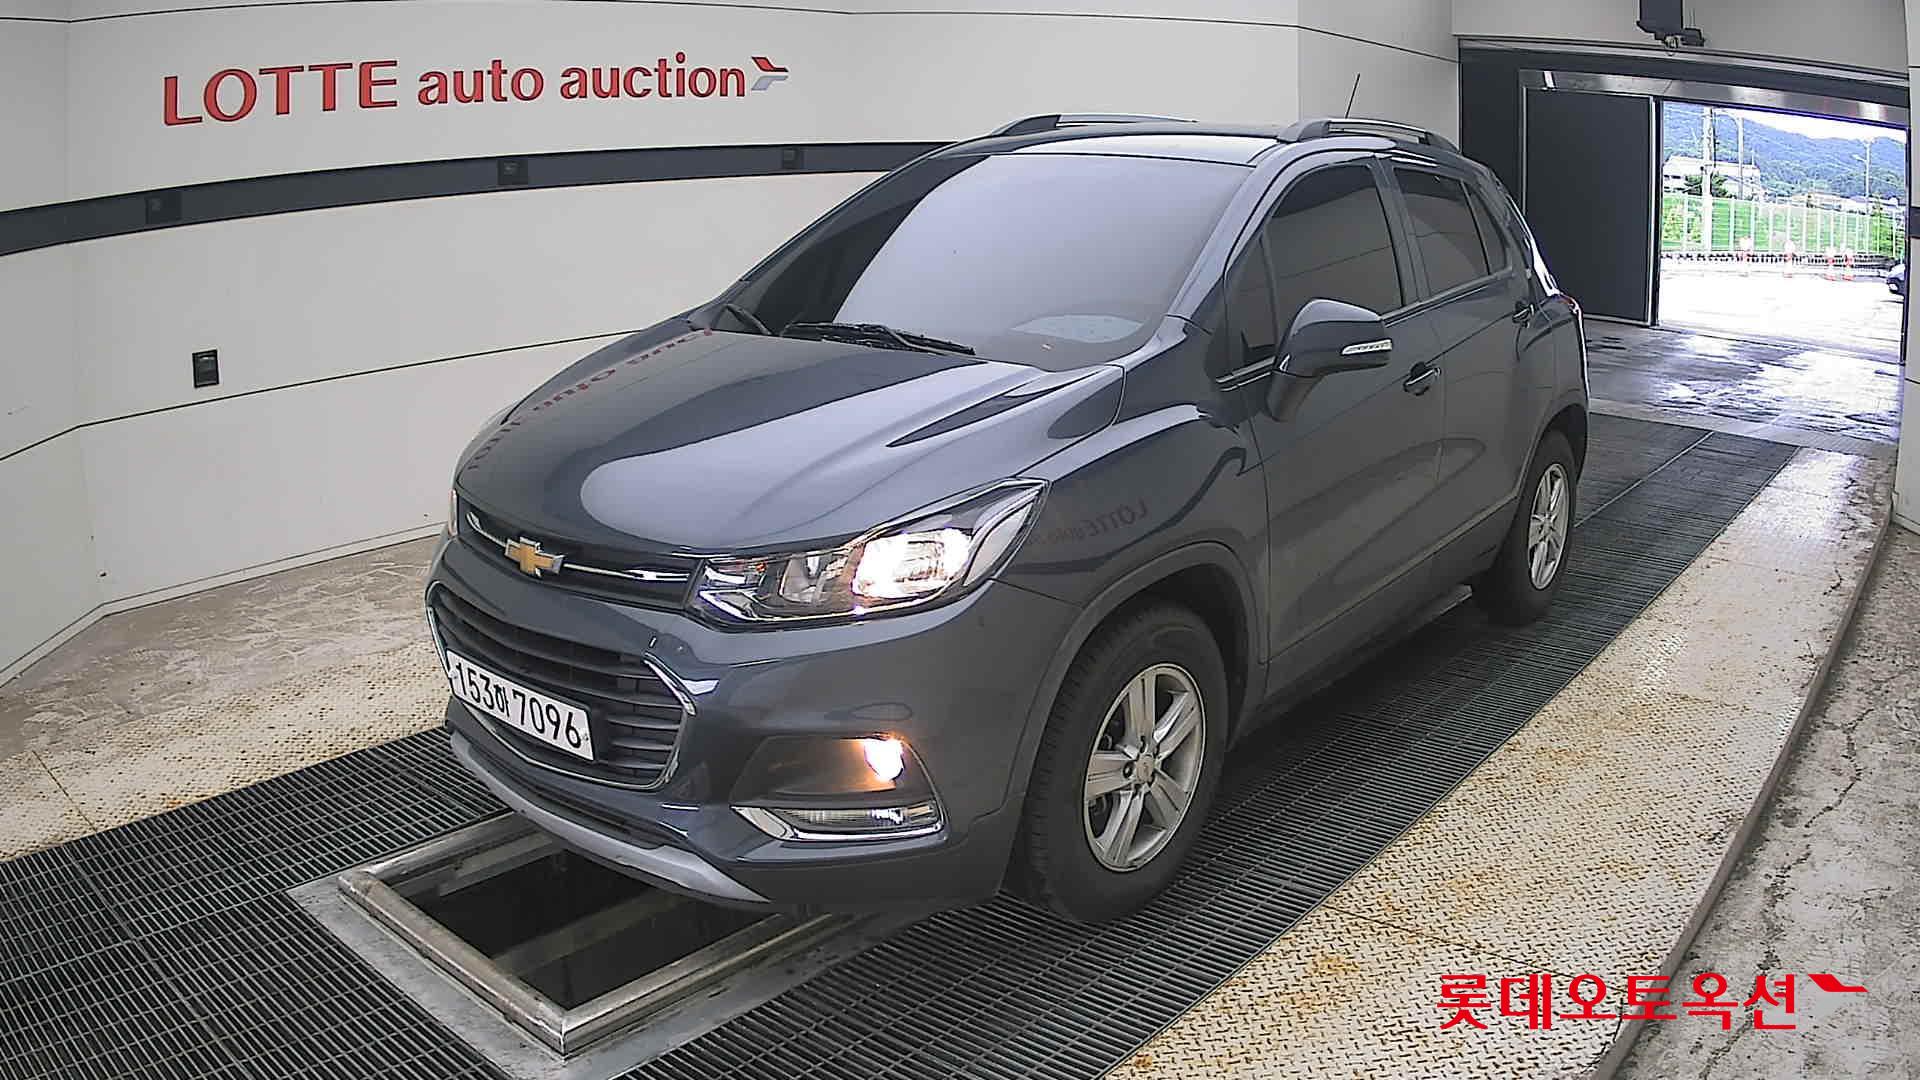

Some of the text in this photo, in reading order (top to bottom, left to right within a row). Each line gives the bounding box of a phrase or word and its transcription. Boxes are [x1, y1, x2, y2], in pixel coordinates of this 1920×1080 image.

[163, 51, 748, 127] LOTTE auto auction
[511, 688, 582, 749] 7096
